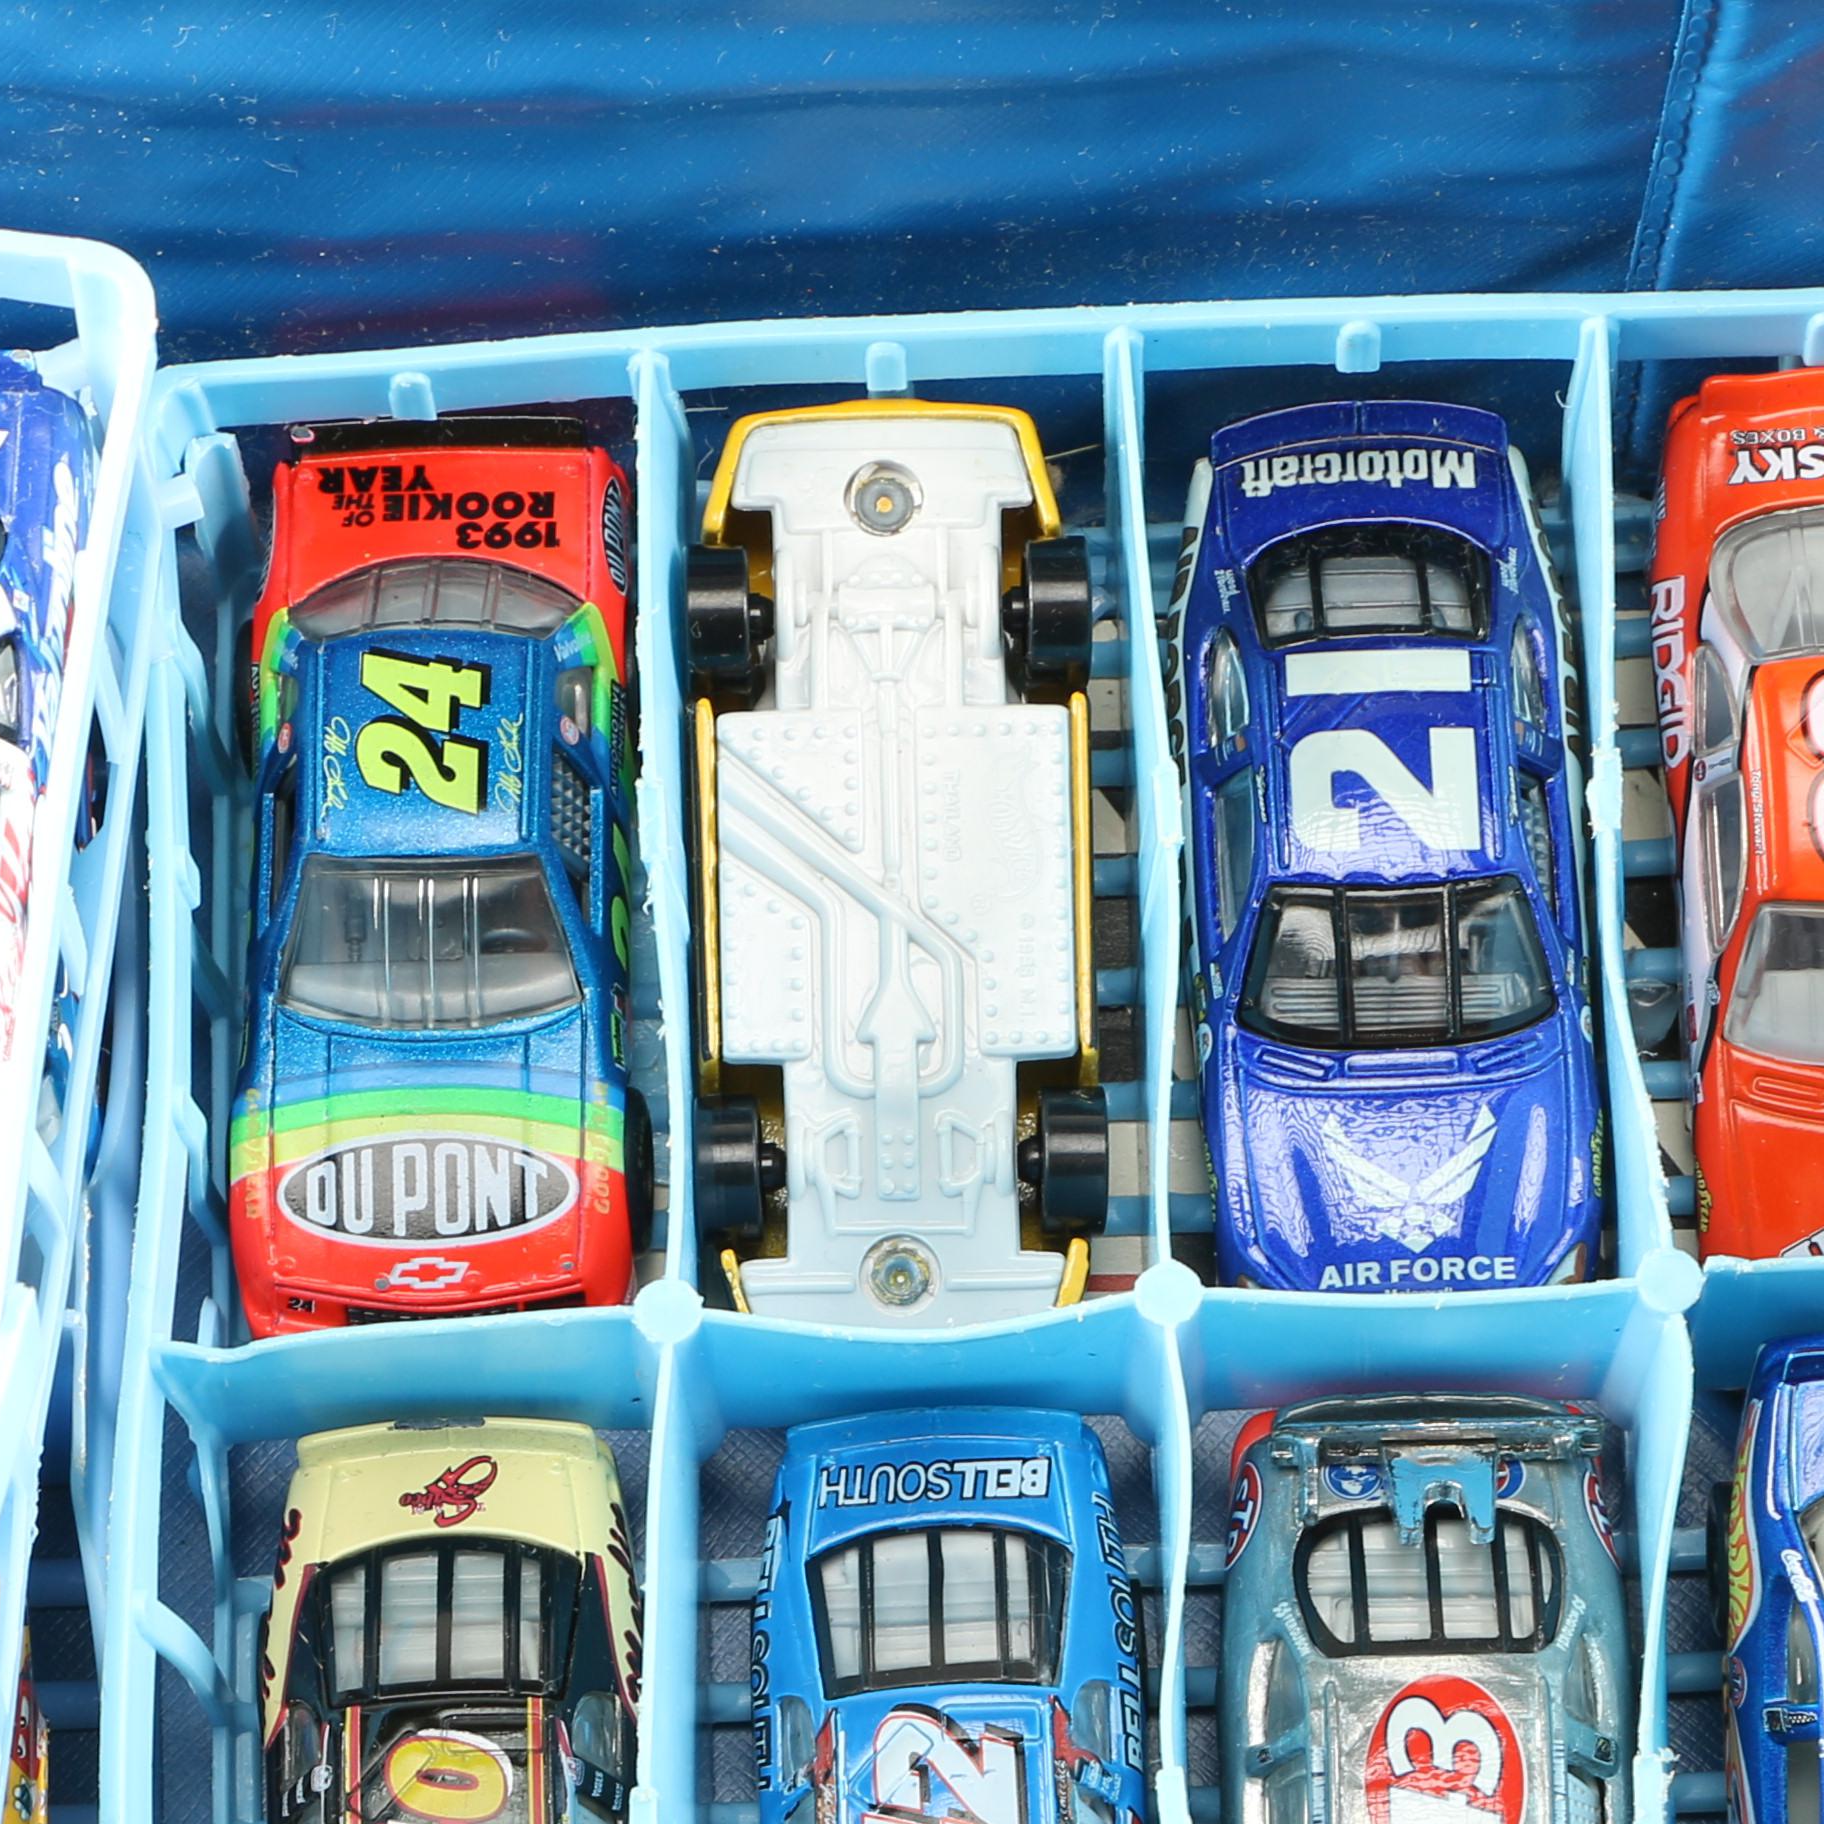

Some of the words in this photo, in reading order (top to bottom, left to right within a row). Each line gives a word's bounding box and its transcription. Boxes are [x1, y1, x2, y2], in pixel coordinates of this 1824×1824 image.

[1731, 427, 1805, 445] BOXES
[317, 464, 433, 493] YEAR
[1241, 449, 1475, 498] Motorcraft
[332, 492, 375, 511] THE
[341, 510, 375, 527] OF
[382, 490, 555, 522] ROOKIE
[456, 521, 560, 549] 1993
[1650, 576, 1691, 770] RIDGID
[355, 650, 489, 816] 24
[1285, 649, 1482, 853] 21
[1752, 768, 1763, 797] Tony
[1753, 798, 1764, 857] Stewart
[1593, 1110, 1604, 1198] GOODYEAR
[306, 1149, 372, 1235] DU
[392, 1142, 547, 1237] PONT
[1319, 1260, 1385, 1290] AIR
[1390, 1257, 1516, 1285] FORCE
[819, 1458, 1051, 1509] BELLSOUTH
[1227, 1481, 1253, 1560] STP
[1092, 1493, 1145, 1774] BELLSOUTH
